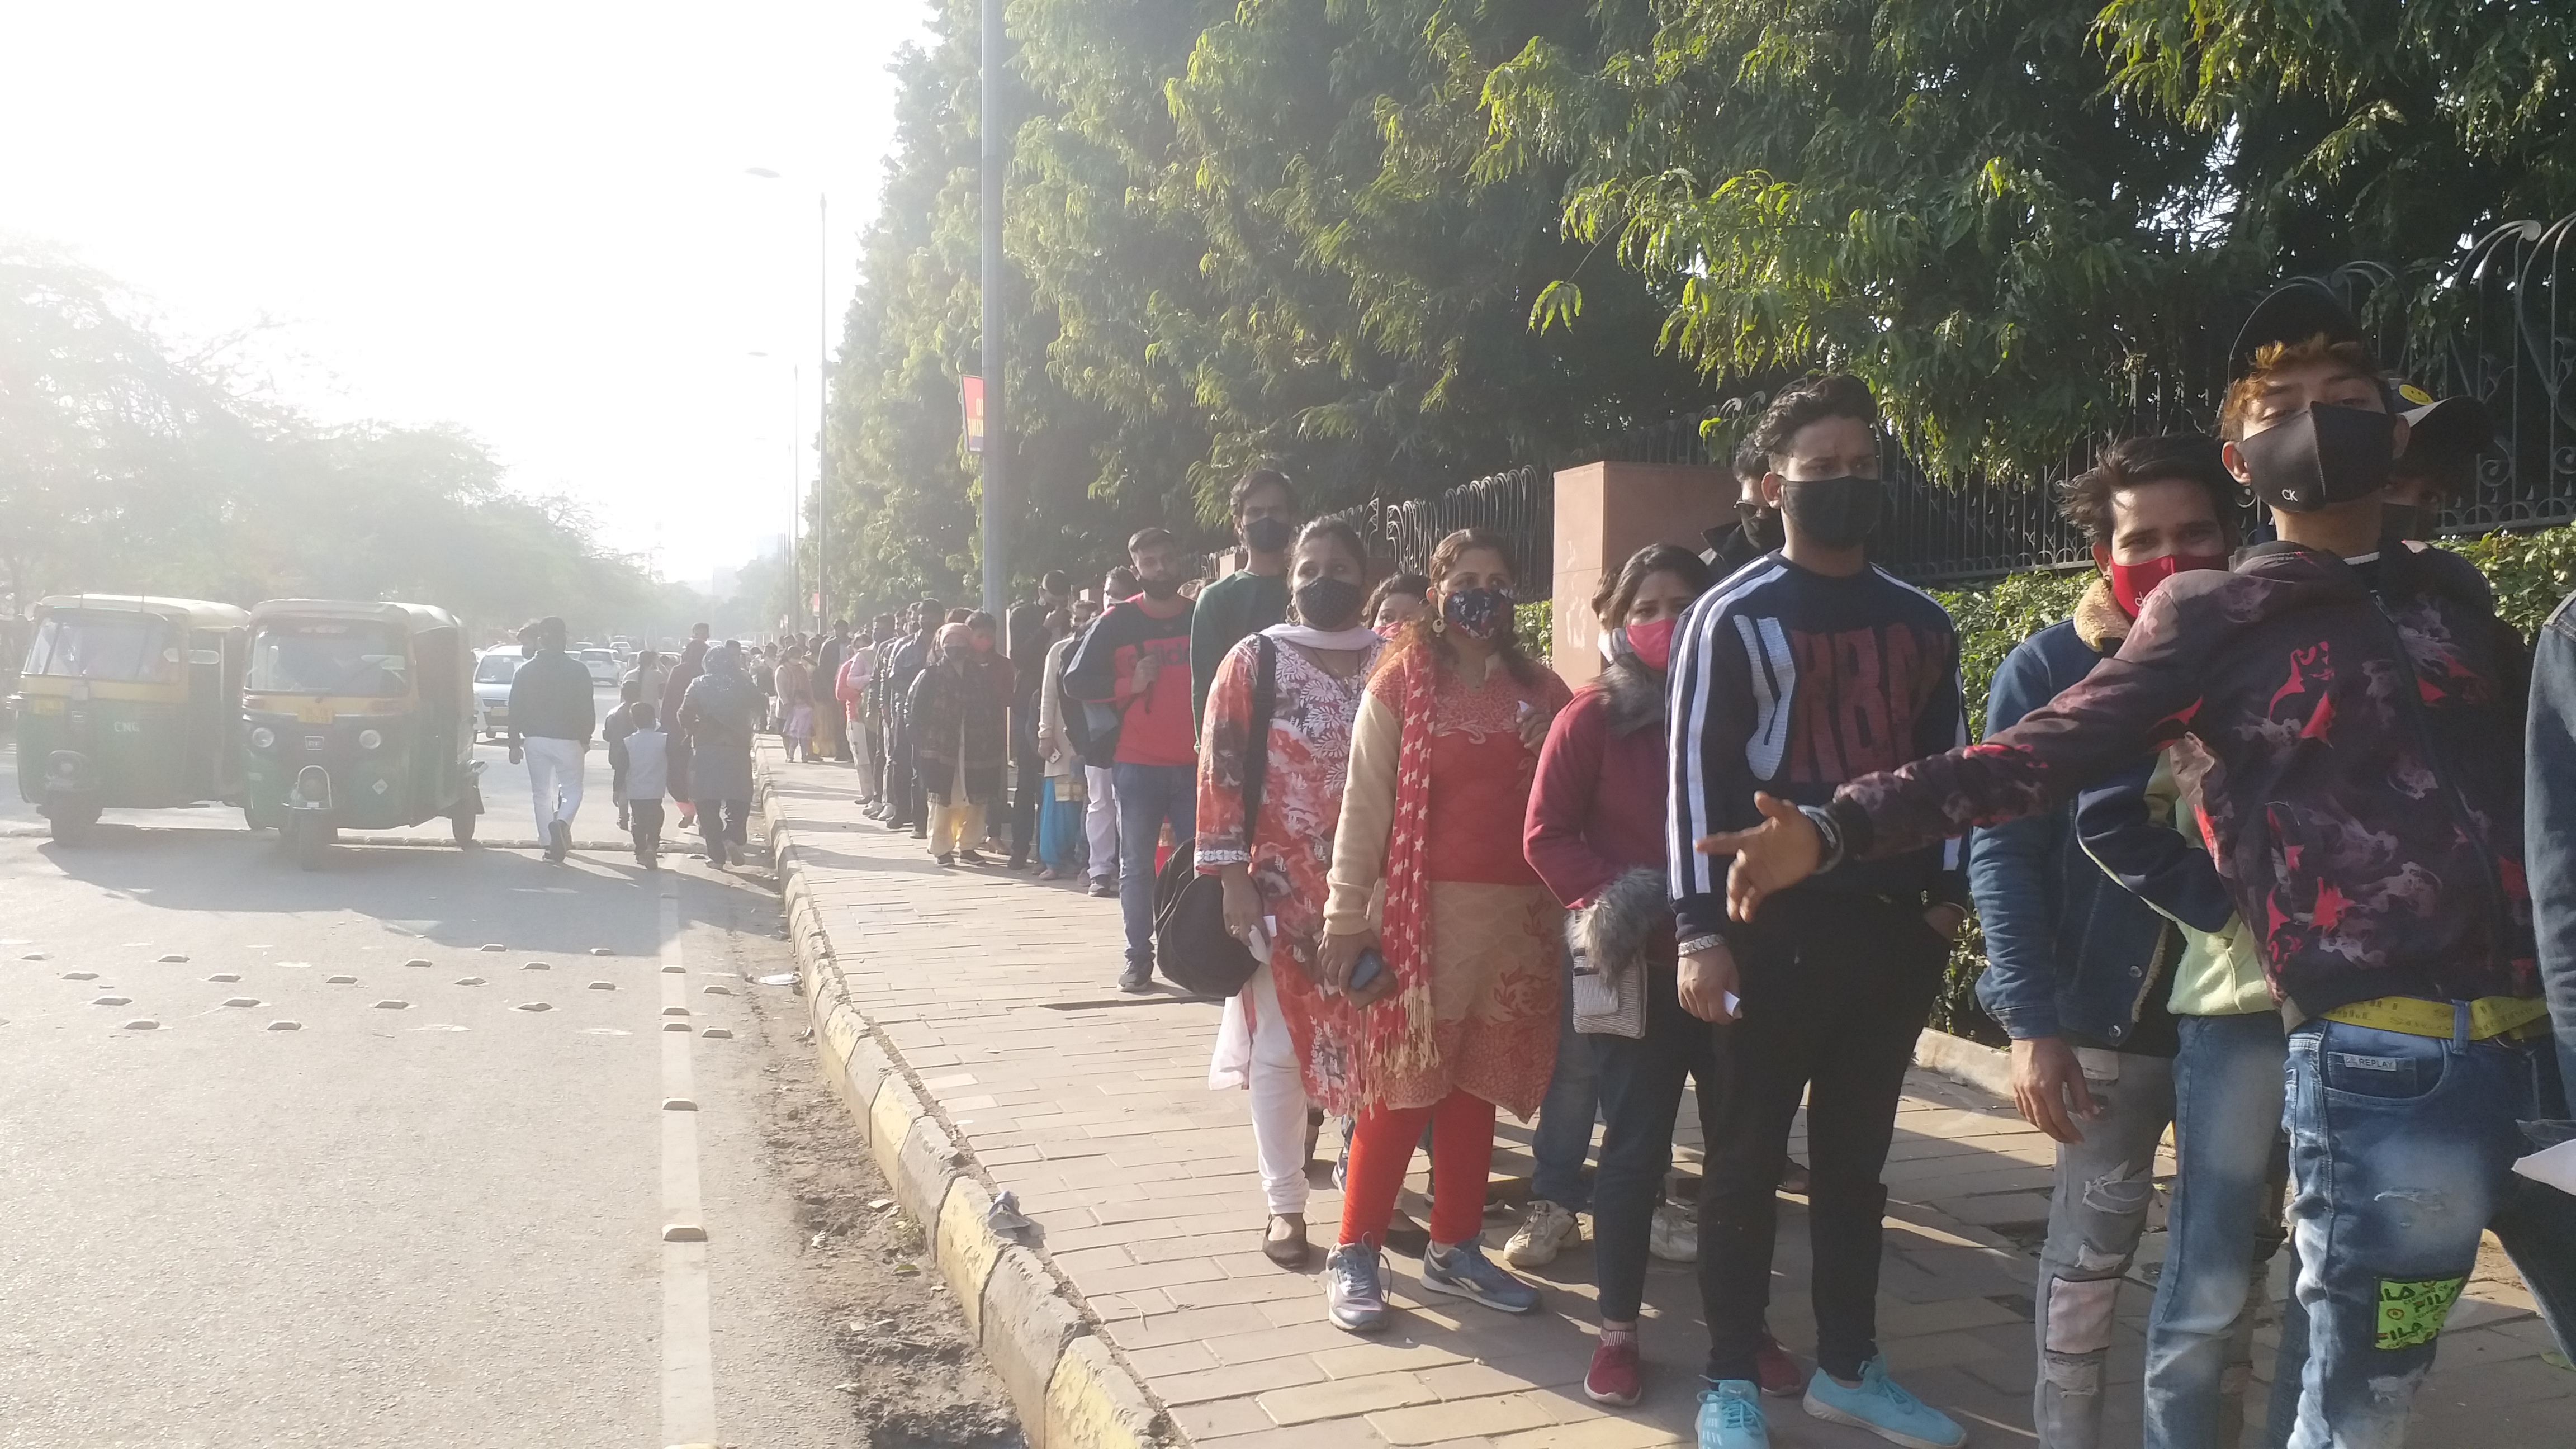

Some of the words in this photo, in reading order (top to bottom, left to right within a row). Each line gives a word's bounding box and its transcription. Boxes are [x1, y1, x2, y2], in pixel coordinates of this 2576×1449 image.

[2281, 489, 2298, 502] CK
[114, 721, 140, 732] CNG
[2359, 1058, 2393, 1068] REPLAY
